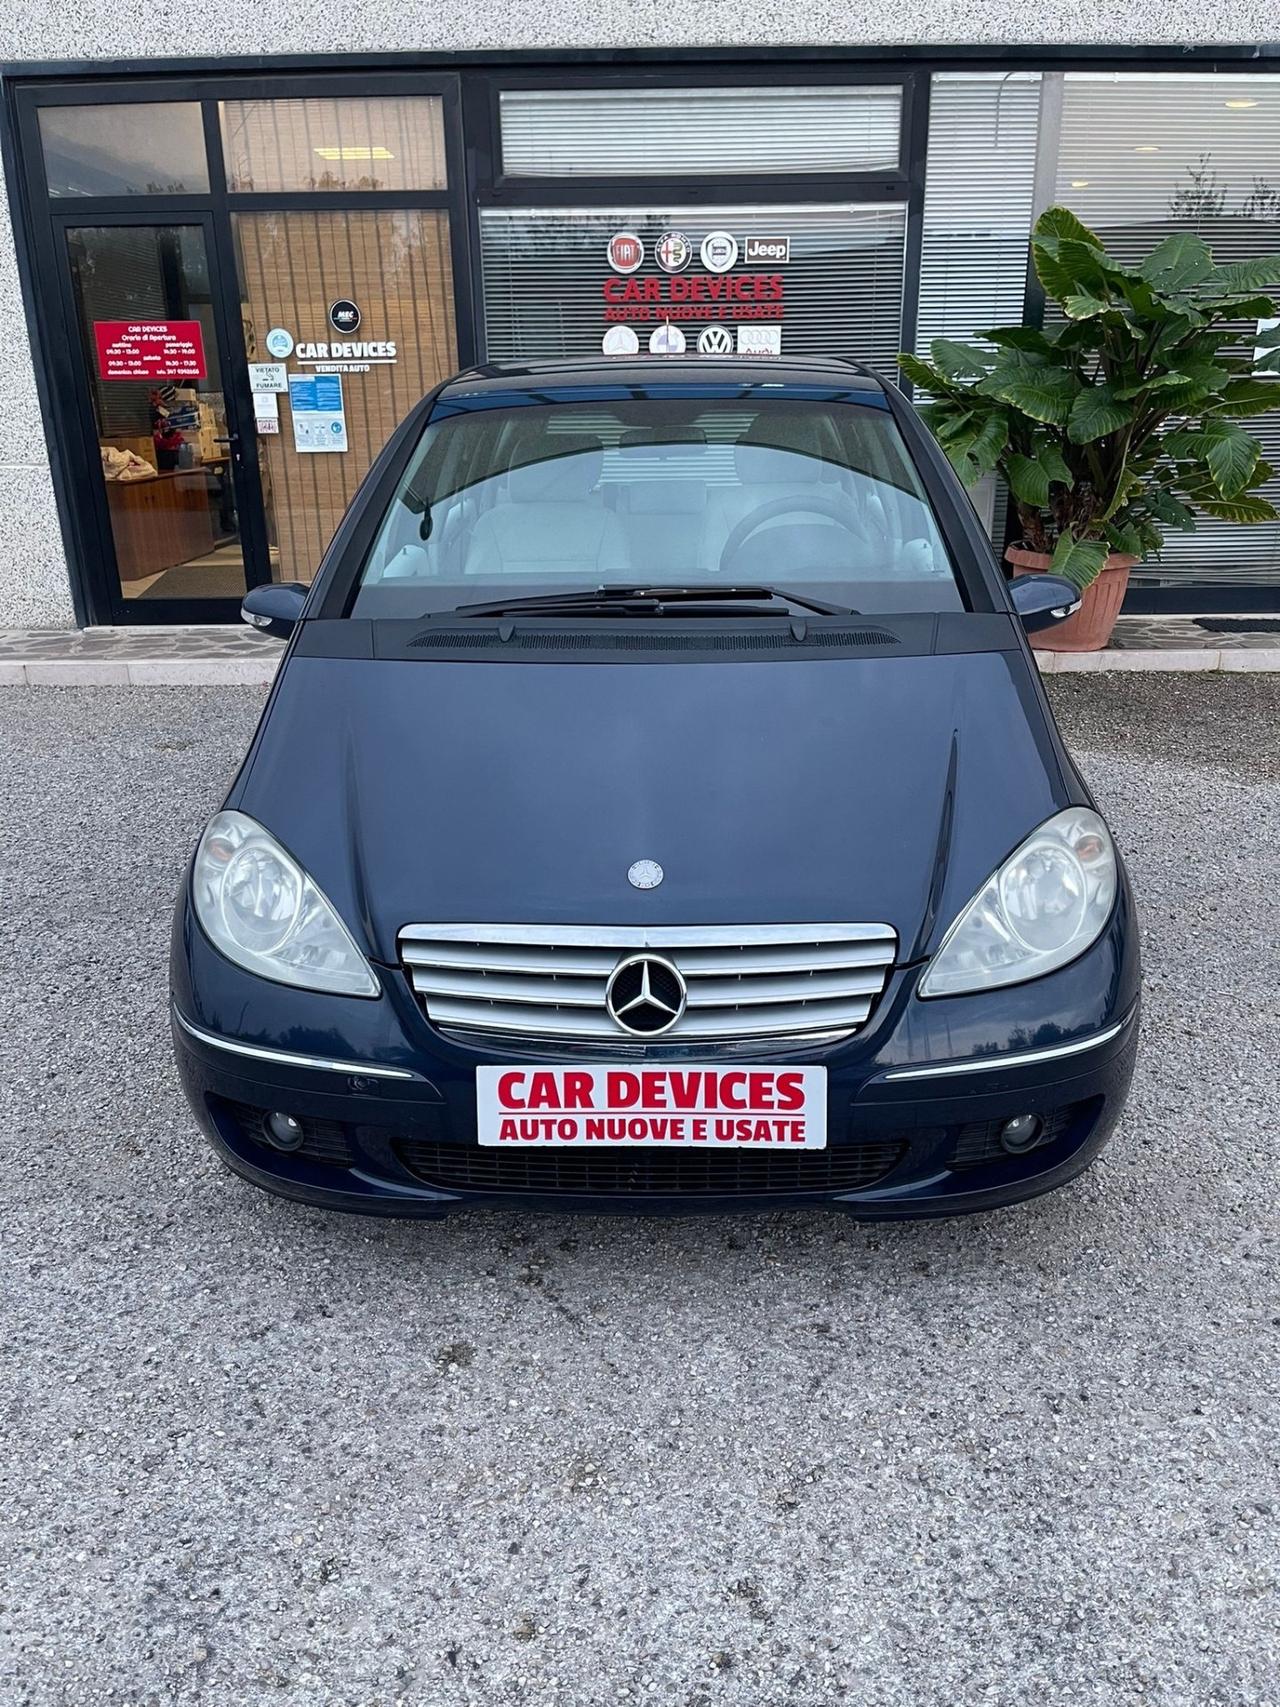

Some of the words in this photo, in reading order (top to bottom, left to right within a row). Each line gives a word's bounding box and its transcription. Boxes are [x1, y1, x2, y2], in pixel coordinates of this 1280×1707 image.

[615, 244, 635, 261] FIAT
[748, 241, 786, 259] Jeep
[603, 277, 661, 302] CAR
[670, 275, 783, 301] DEVICES
[604, 306, 650, 321] AUTO
[295, 343, 329, 358] CAR
[331, 342, 397, 357] DEVICES
[315, 365, 349, 373] VENDITA
[498, 1071, 595, 1109] CAR
[607, 1071, 806, 1111] DEVICES
[499, 1118, 578, 1141] AUTO
[585, 1118, 685, 1141] NUOVE
[692, 1119, 708, 1141] E
[715, 1119, 806, 1142] USATE
